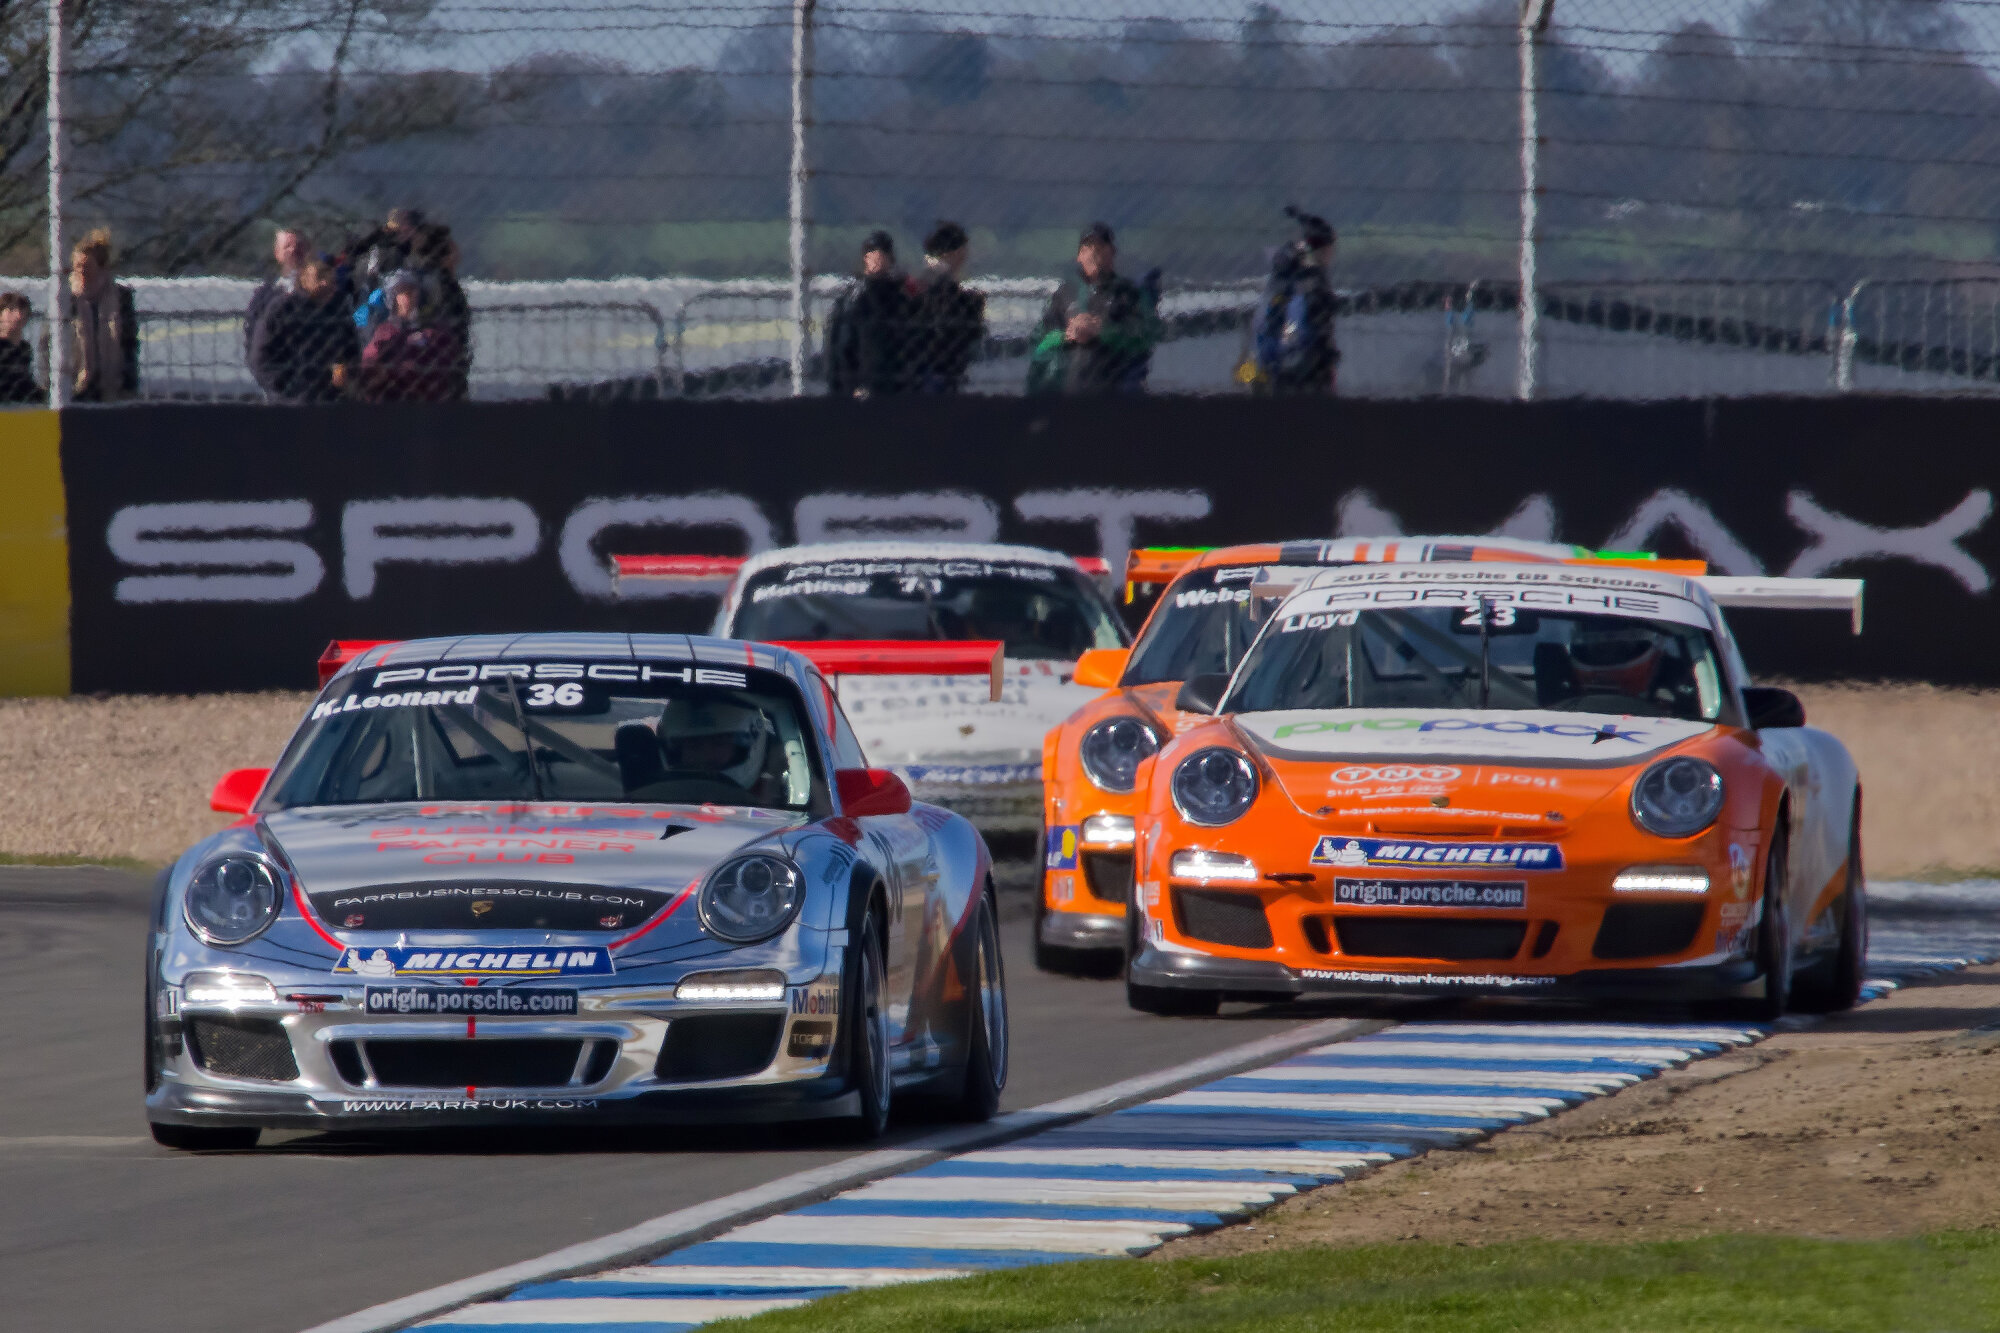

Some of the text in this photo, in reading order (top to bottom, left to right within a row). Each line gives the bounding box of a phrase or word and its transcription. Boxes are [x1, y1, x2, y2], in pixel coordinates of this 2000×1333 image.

[107, 488, 1211, 604] SPORT
[786, 563, 1055, 582] PORSCHE
[1334, 571, 1390, 583] 2012
[1400, 570, 1507, 582] Porsche
[1559, 574, 1662, 589] Scholar
[1326, 589, 1659, 613] PORSCHE
[1282, 605, 1516, 632] Lloyd 23
[374, 664, 747, 688] PORSCHE
[311, 683, 584, 720] K.Leonard 36
[1273, 716, 1652, 745] propack
[1331, 766, 1462, 785] TNT
[369, 826, 656, 841] BUSINESS
[377, 838, 636, 854] PARTNER
[1376, 844, 1551, 863] MICHELIN
[423, 852, 575, 865] CLUB
[334, 887, 645, 907] PARRBUSINESSCLUB.COM
[1340, 880, 1522, 904] origin.porsche.com
[403, 951, 599, 969] MICHELIN
[1301, 967, 1557, 987] www.teamparkerracing.com
[369, 987, 574, 1013] origin.porsche.com
